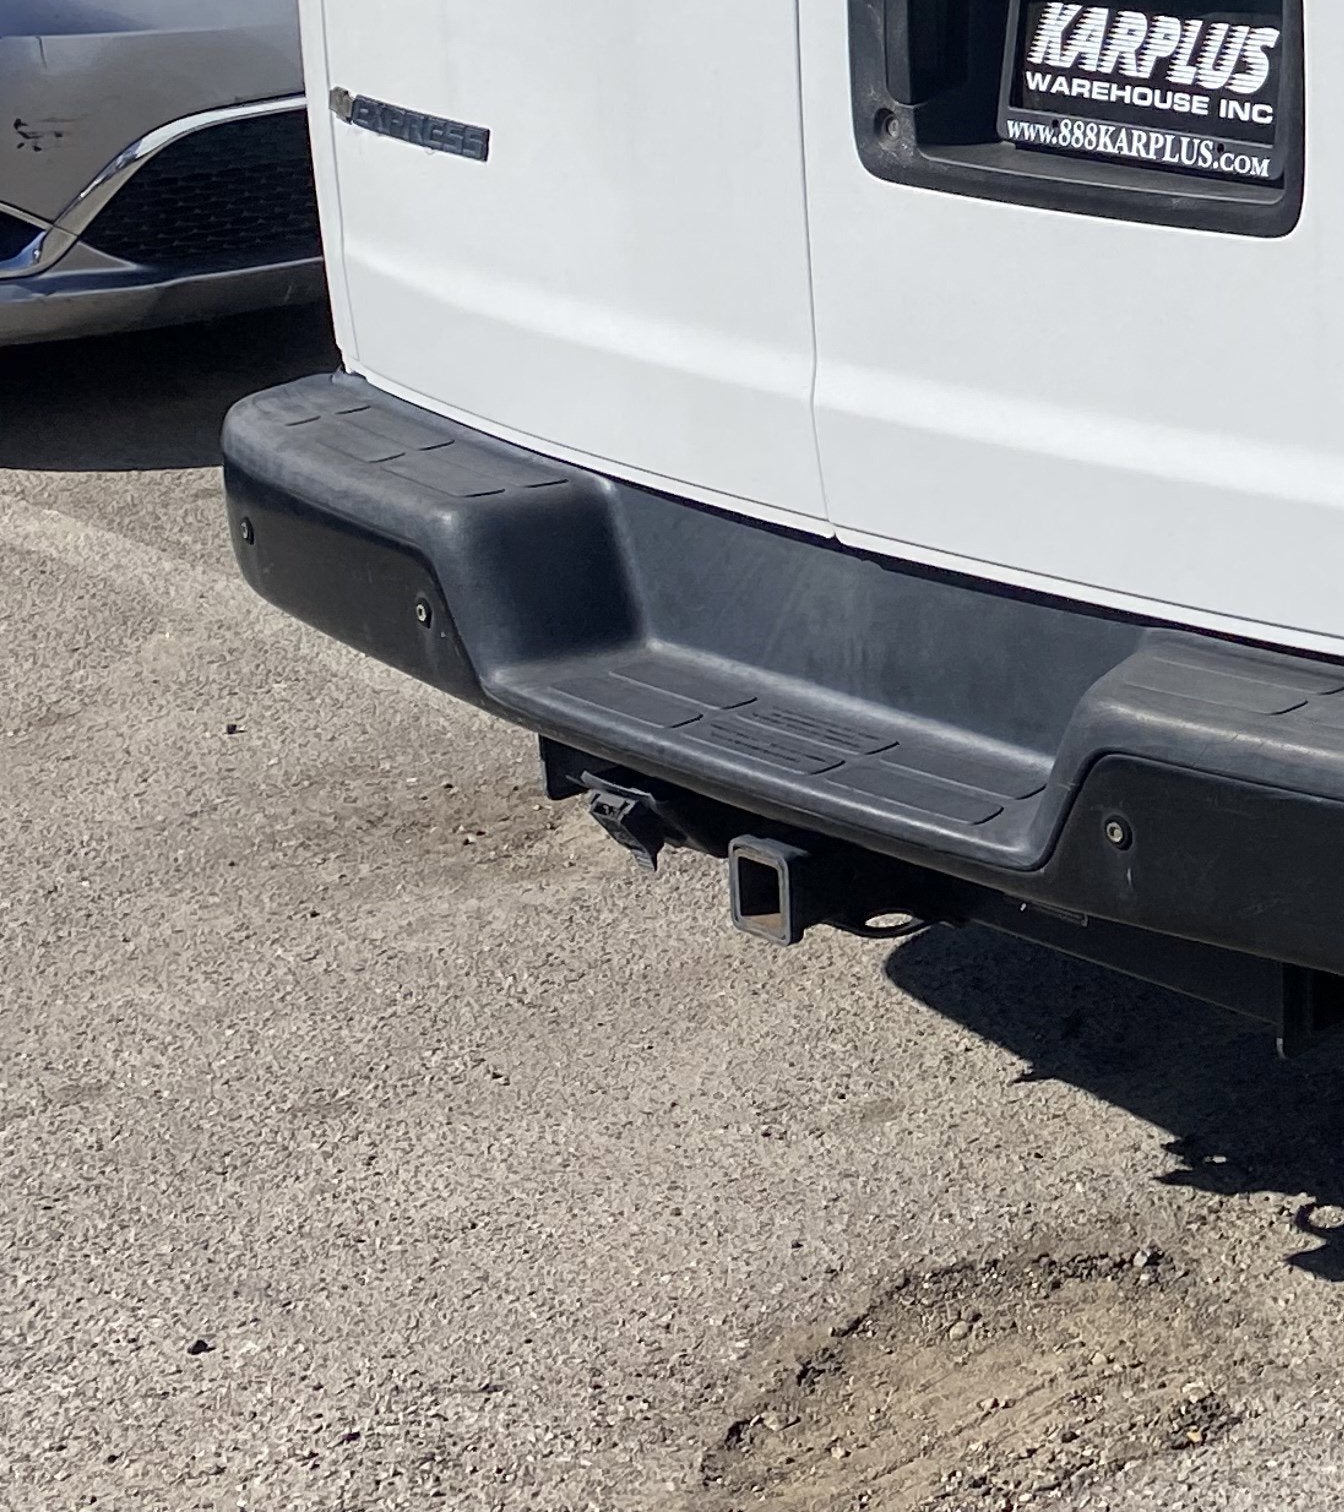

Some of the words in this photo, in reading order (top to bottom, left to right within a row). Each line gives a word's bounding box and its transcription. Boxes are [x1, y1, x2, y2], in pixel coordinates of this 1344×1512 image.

[1027, 2, 1280, 94] KARPLUS
[1025, 70, 1210, 116] WAREHOUSE
[1219, 99, 1273, 124] INC
